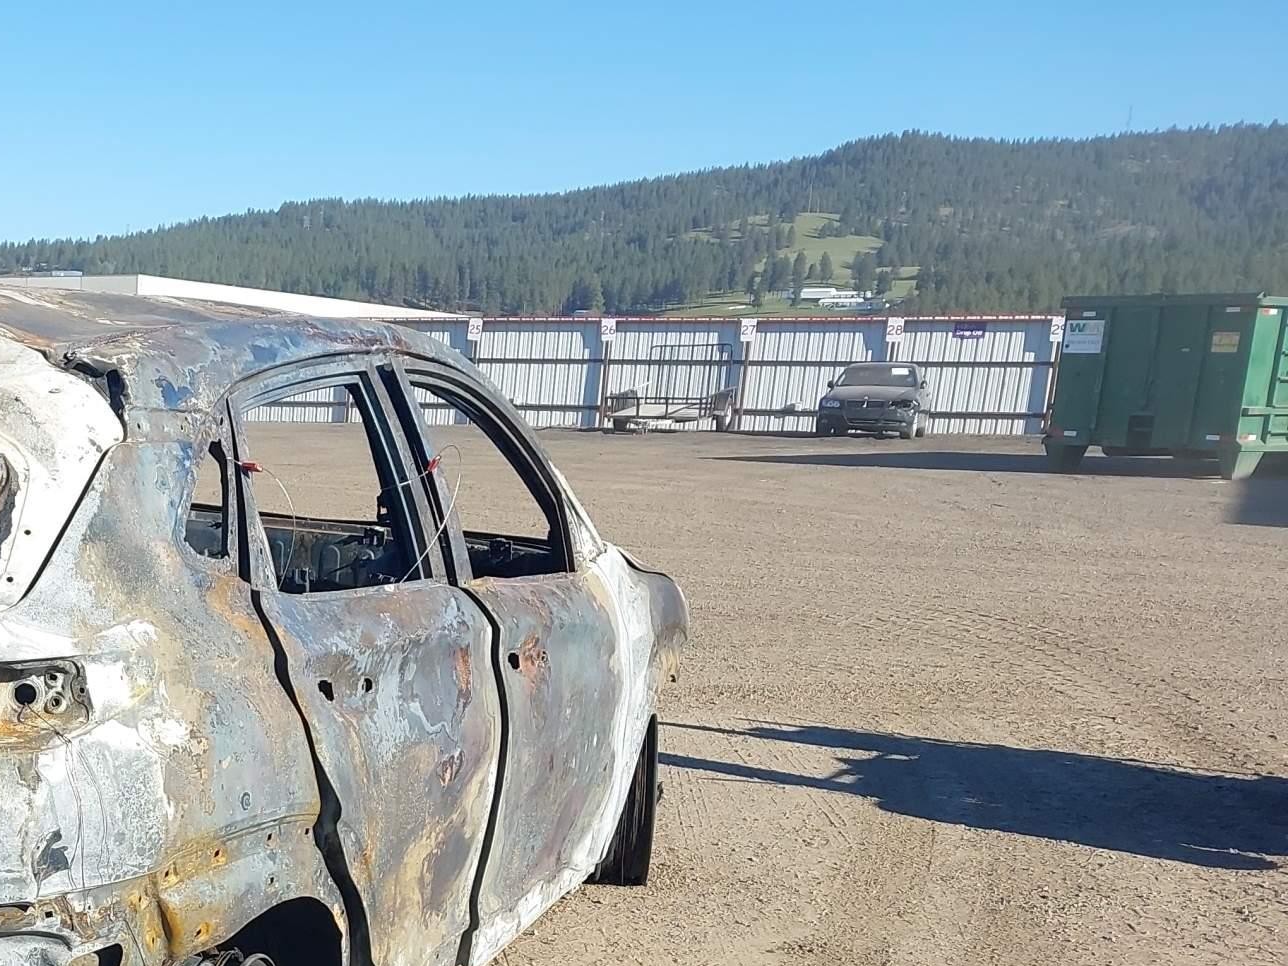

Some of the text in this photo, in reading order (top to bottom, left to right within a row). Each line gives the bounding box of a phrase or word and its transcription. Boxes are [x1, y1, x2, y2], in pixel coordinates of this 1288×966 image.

[469, 324, 481, 334] 25
[601, 325, 616, 335] 26
[741, 324, 756, 336] 27
[887, 324, 903, 336] 28
